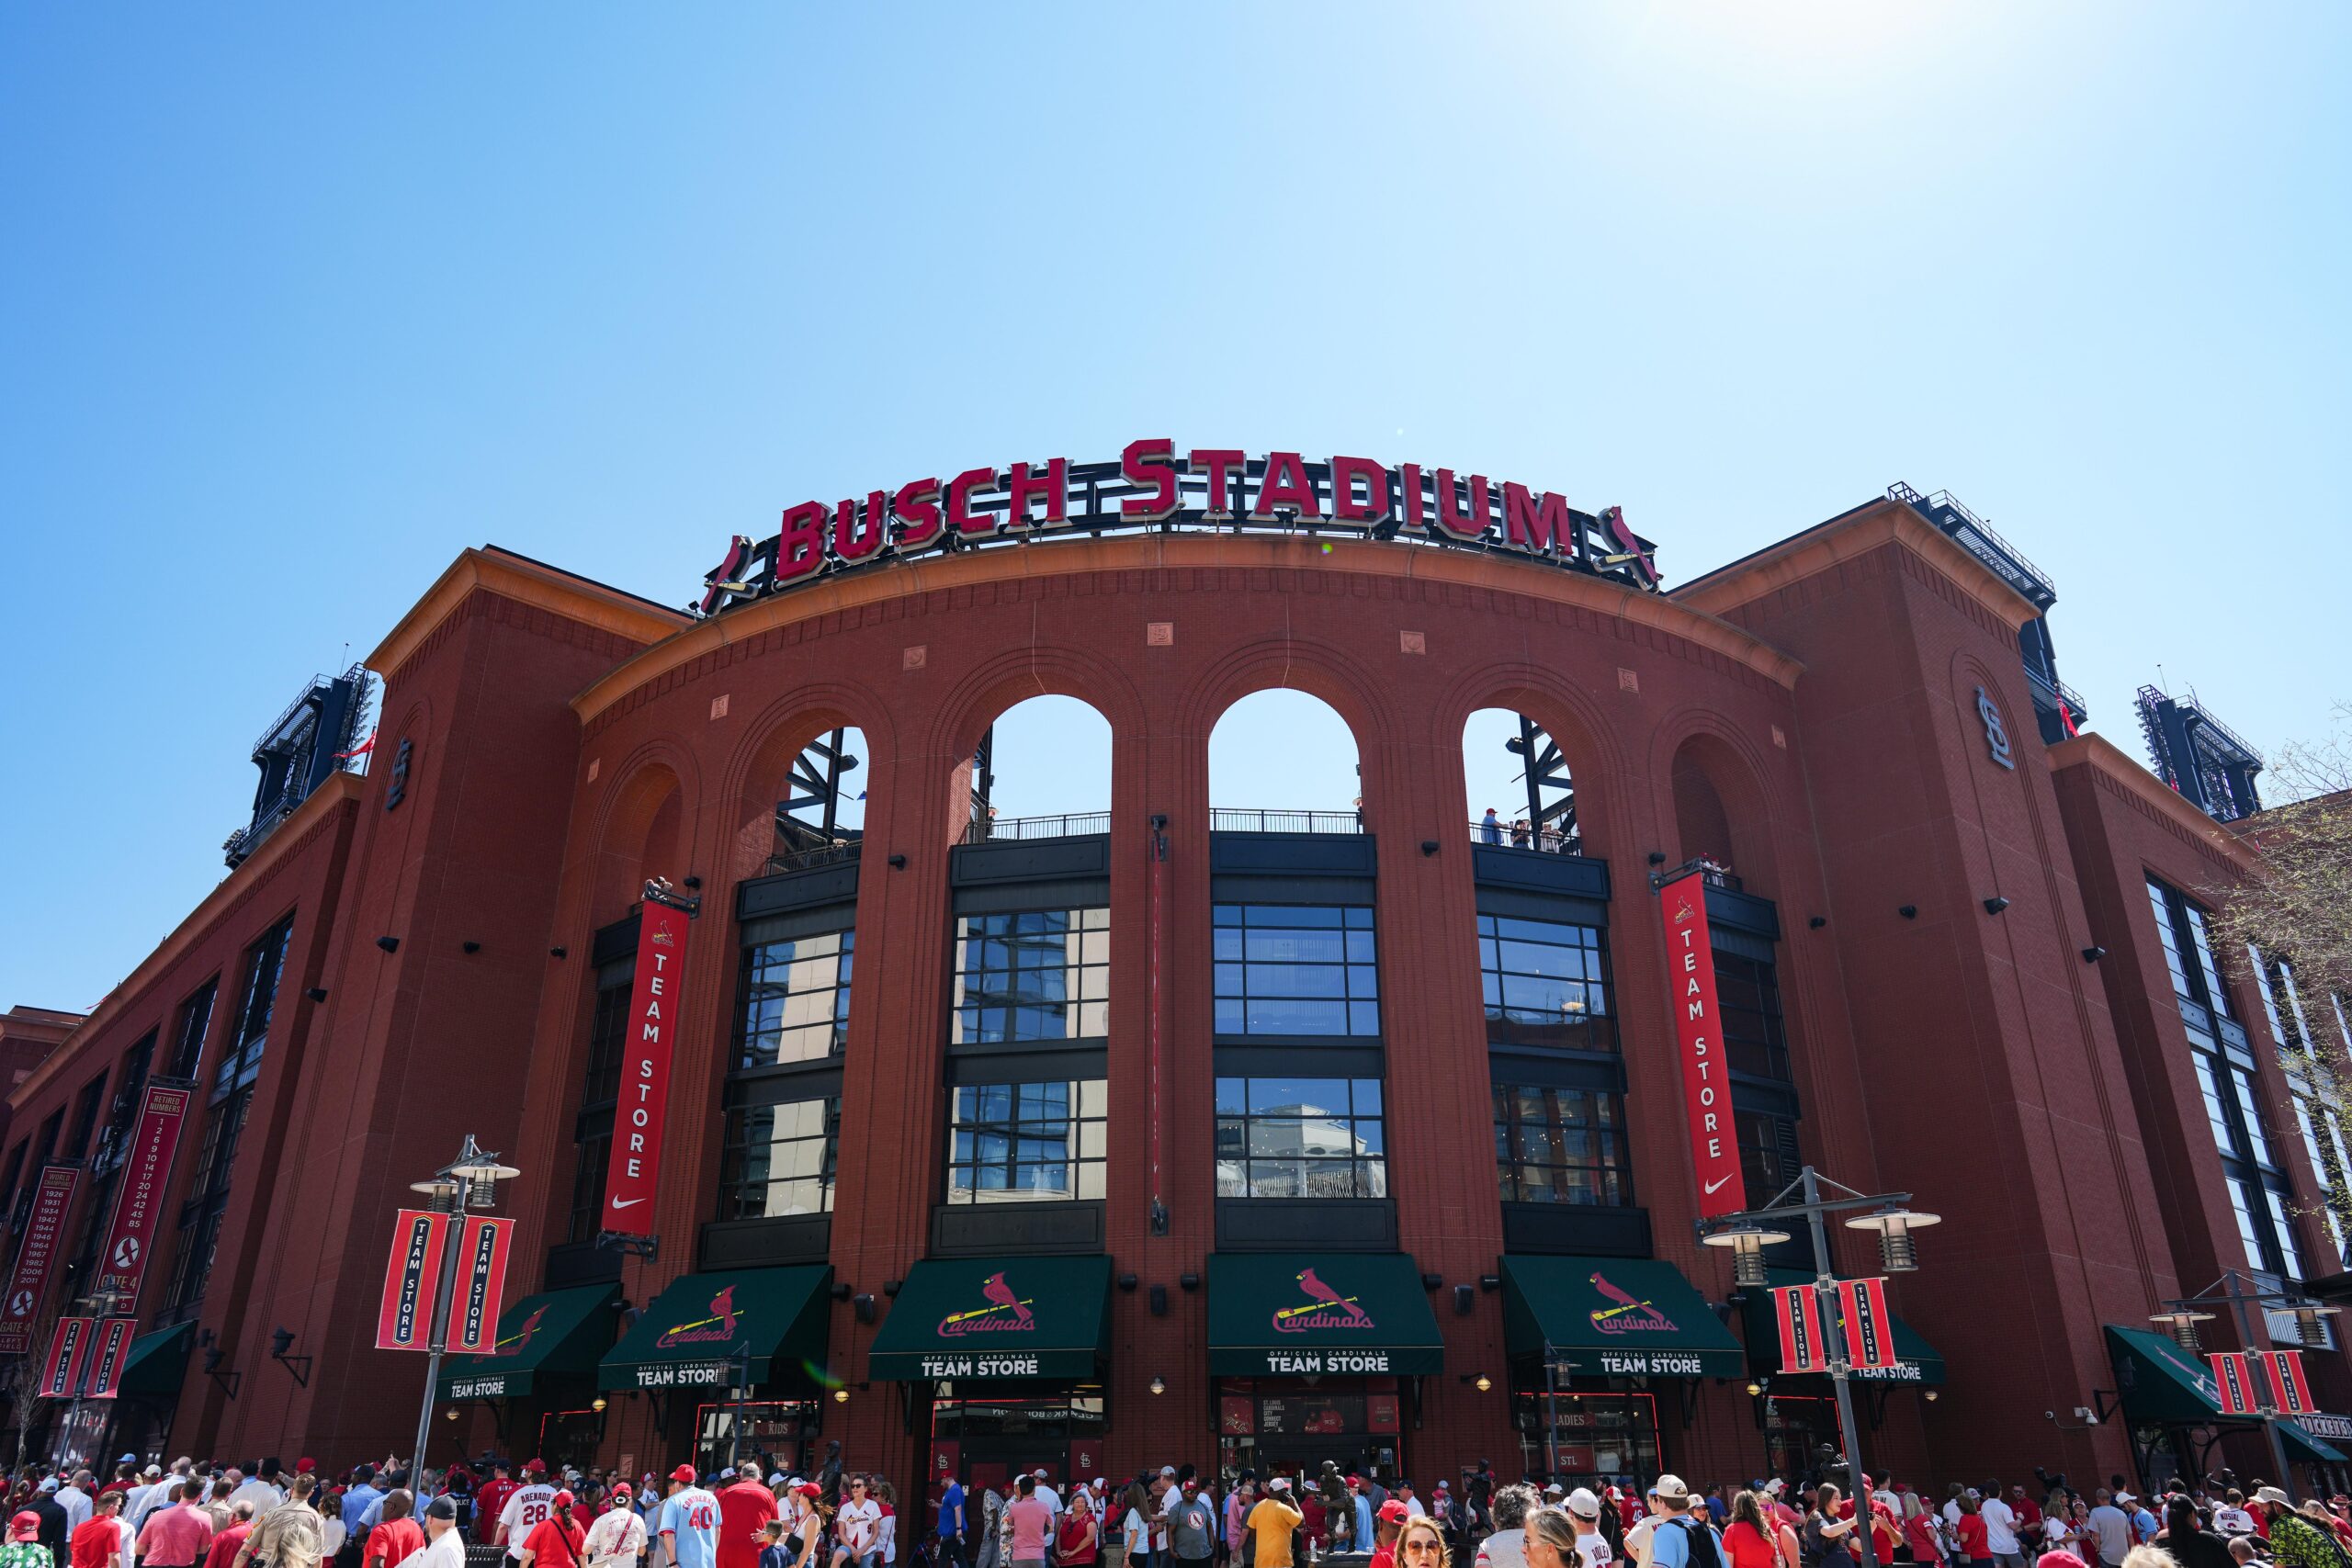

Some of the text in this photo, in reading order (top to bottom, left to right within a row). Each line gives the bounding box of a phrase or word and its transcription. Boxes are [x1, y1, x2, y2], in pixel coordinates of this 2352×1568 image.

[775, 438, 1574, 588] BUSCH STADIUM
[643, 953, 667, 1043] TEAM
[1680, 929, 1704, 1021] TEAM
[1695, 1037, 1721, 1158] STORE
[149, 1104, 181, 1113] NUMBERS
[153, 1095, 181, 1105] RETIRED
[627, 1058, 653, 1179] STORE
[49, 1173, 70, 1181] WORLD
[128, 1220, 141, 1228] 85
[129, 1278, 137, 1289] 4
[401, 1224, 426, 1337] TEAM STORE
[469, 1229, 492, 1341] TEAM STORE
[0, 1322, 24, 1332] GATE
[938, 1312, 1035, 1337] Cardinals
[1272, 1307, 1375, 1333] Cardinals
[1589, 1310, 1679, 1335] Cardinals
[1792, 1293, 1806, 1365] TEAM STORE
[1858, 1287, 1875, 1360] TEAM STORE
[656, 1325, 735, 1348] Cardinals
[56, 1325, 77, 1392] TEAM STORE
[98, 1325, 121, 1392] TEAM STORE
[922, 1359, 1038, 1376] TEAM STORE
[1267, 1357, 1389, 1372] TEAM STORE
[1600, 1358, 1702, 1373] TEAM STORE
[637, 1371, 674, 1385] TEAM
[1858, 1366, 1922, 1380] TEAM STORE
[2225, 1359, 2242, 1409] TEAM STORE
[2278, 1356, 2297, 1408] TEAM STORE
[451, 1381, 504, 1398] TEAM STORE
[768, 1424, 788, 1434] KIDS
[1561, 1456, 1577, 1465] STL
[521, 1493, 551, 1504] ARENADO
[523, 1504, 548, 1525] 28
[689, 1506, 713, 1531] 40
